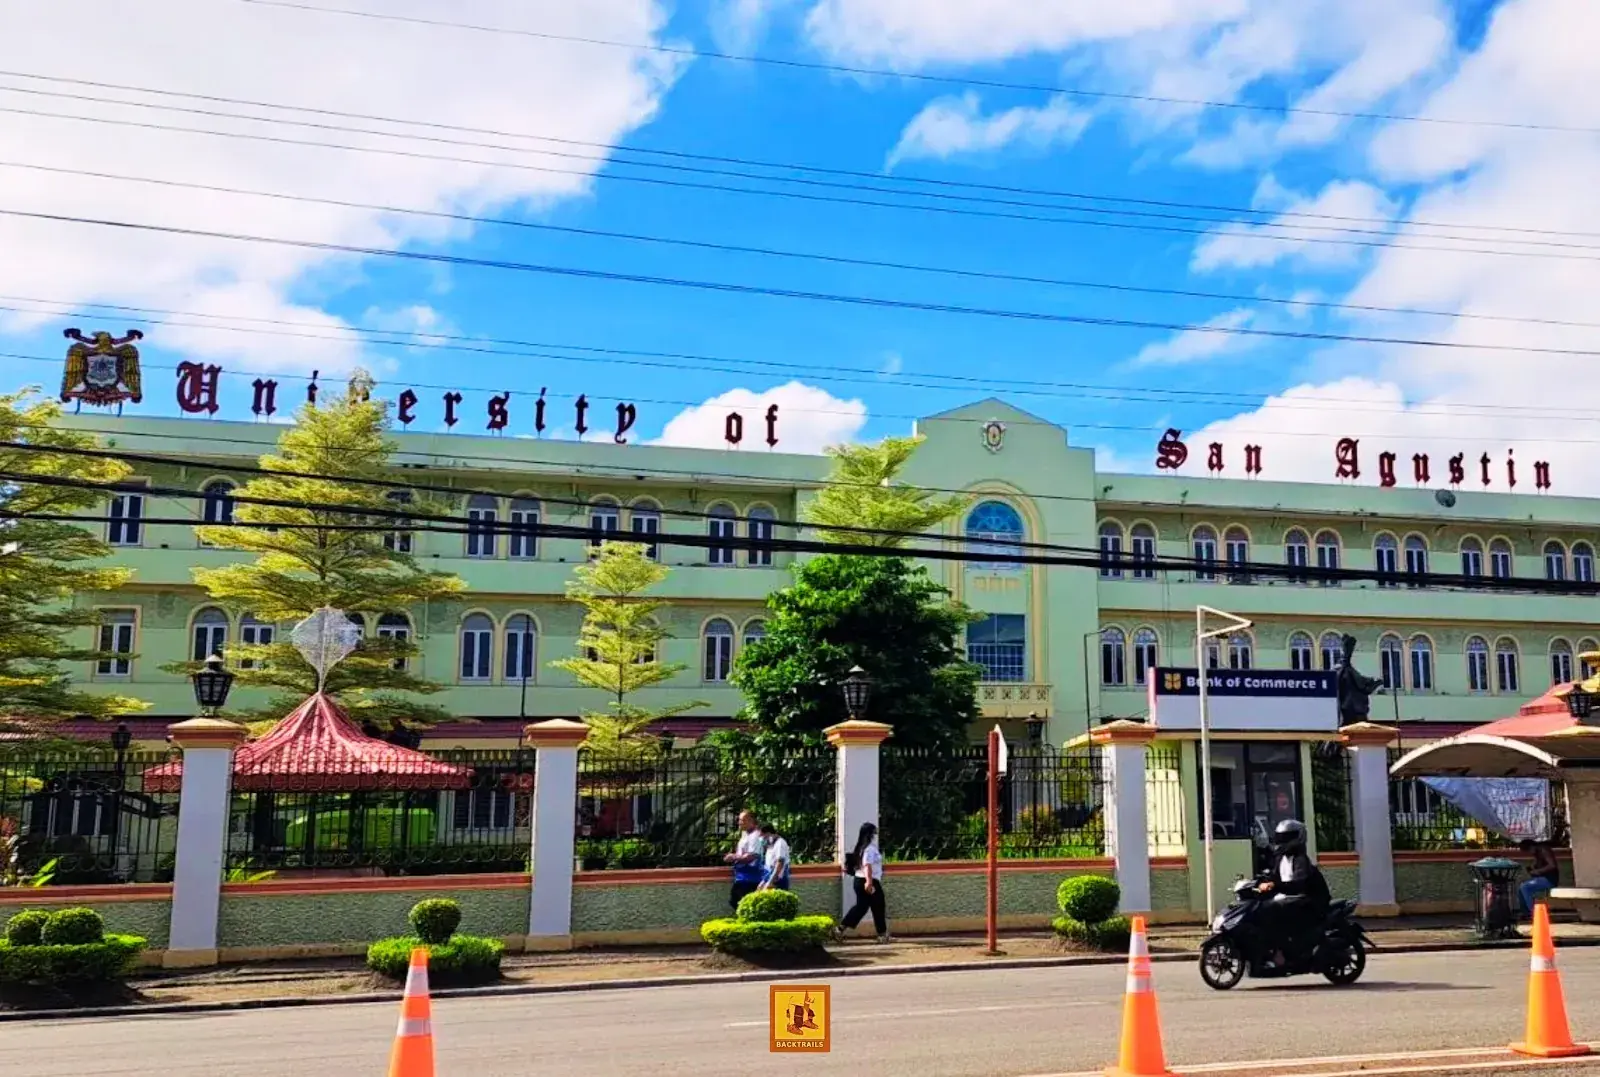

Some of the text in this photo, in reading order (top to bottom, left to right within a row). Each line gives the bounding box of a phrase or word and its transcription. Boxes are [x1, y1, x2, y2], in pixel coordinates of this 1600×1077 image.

[725, 404, 779, 447] of
[1156, 428, 1263, 475] San
[1335, 437, 1552, 489] Agustin
[1226, 677, 1241, 688] of
[1244, 678, 1316, 689] Commerce
